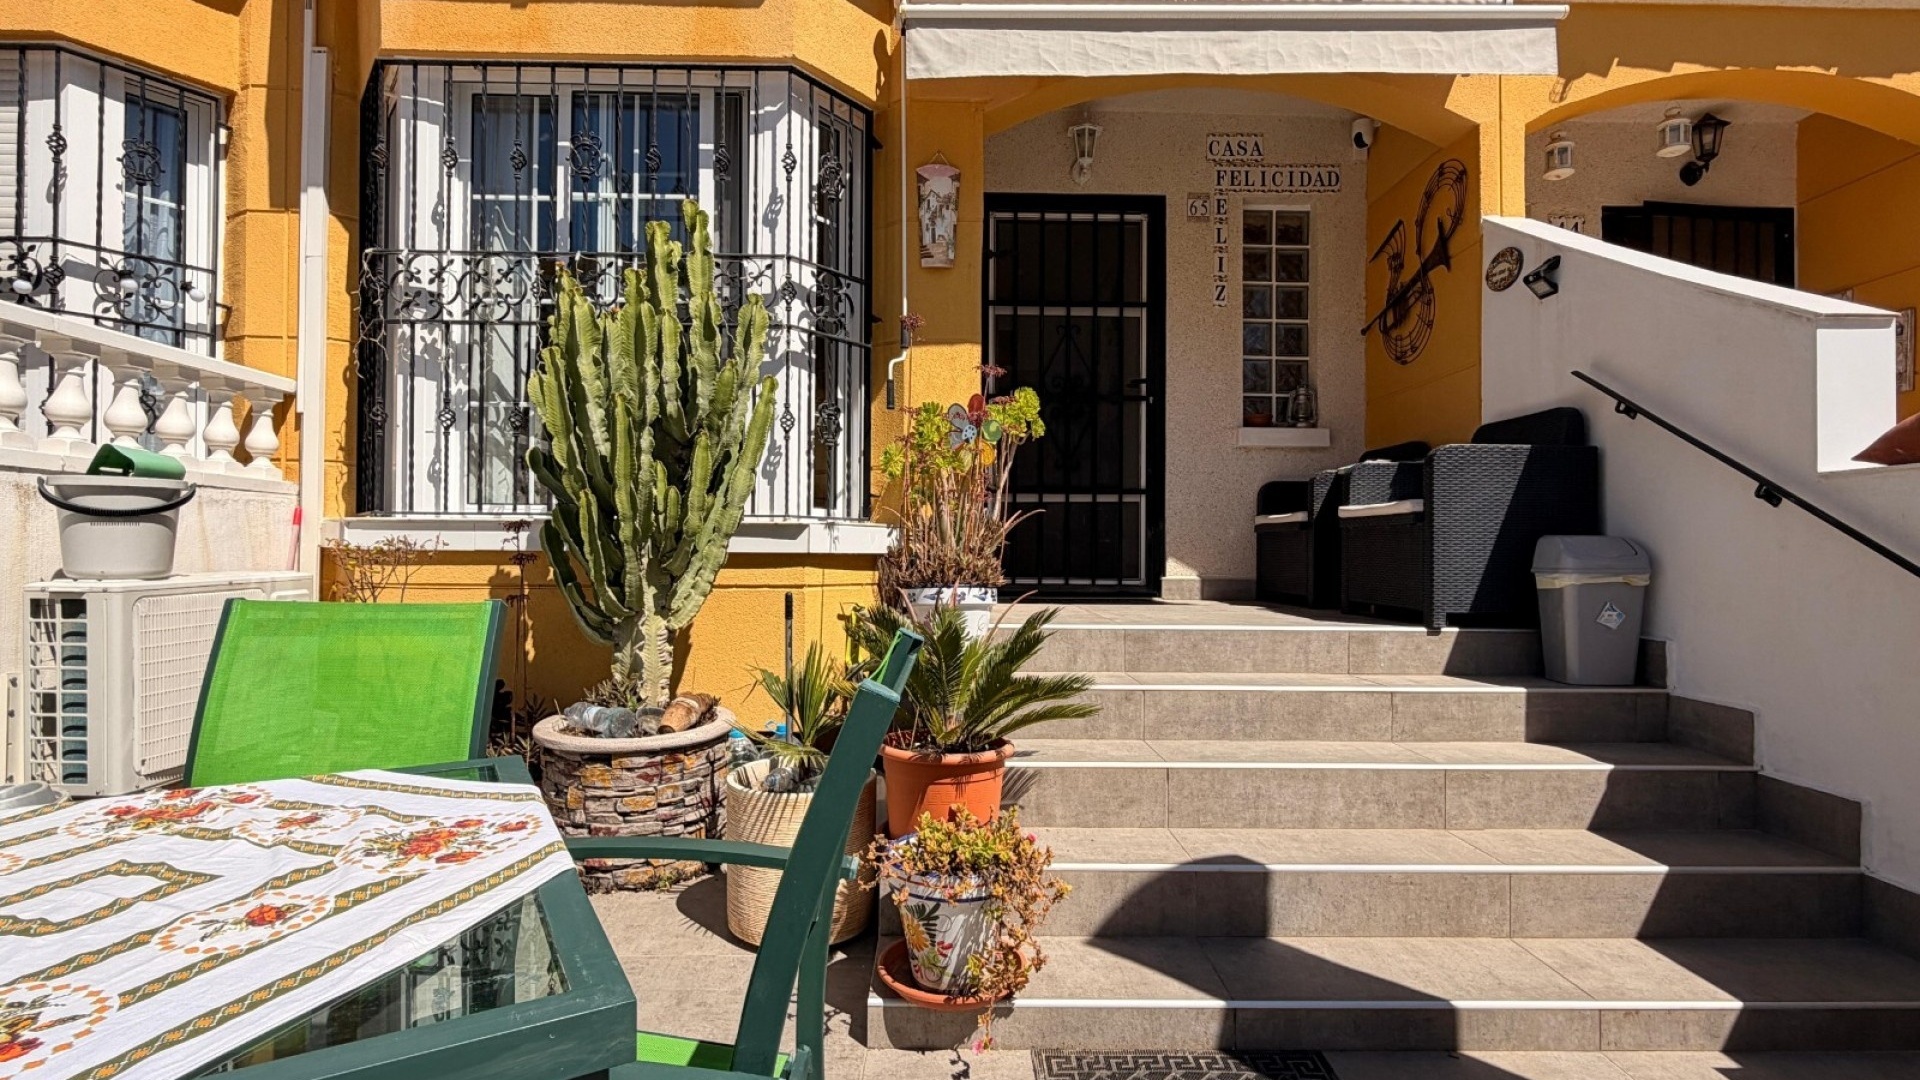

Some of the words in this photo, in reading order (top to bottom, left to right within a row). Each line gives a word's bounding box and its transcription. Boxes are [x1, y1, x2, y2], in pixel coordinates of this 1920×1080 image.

[1208, 140, 1263, 157] CASA
[1216, 170, 1340, 187] FELICIDAD
[1189, 200, 1208, 216] 65
